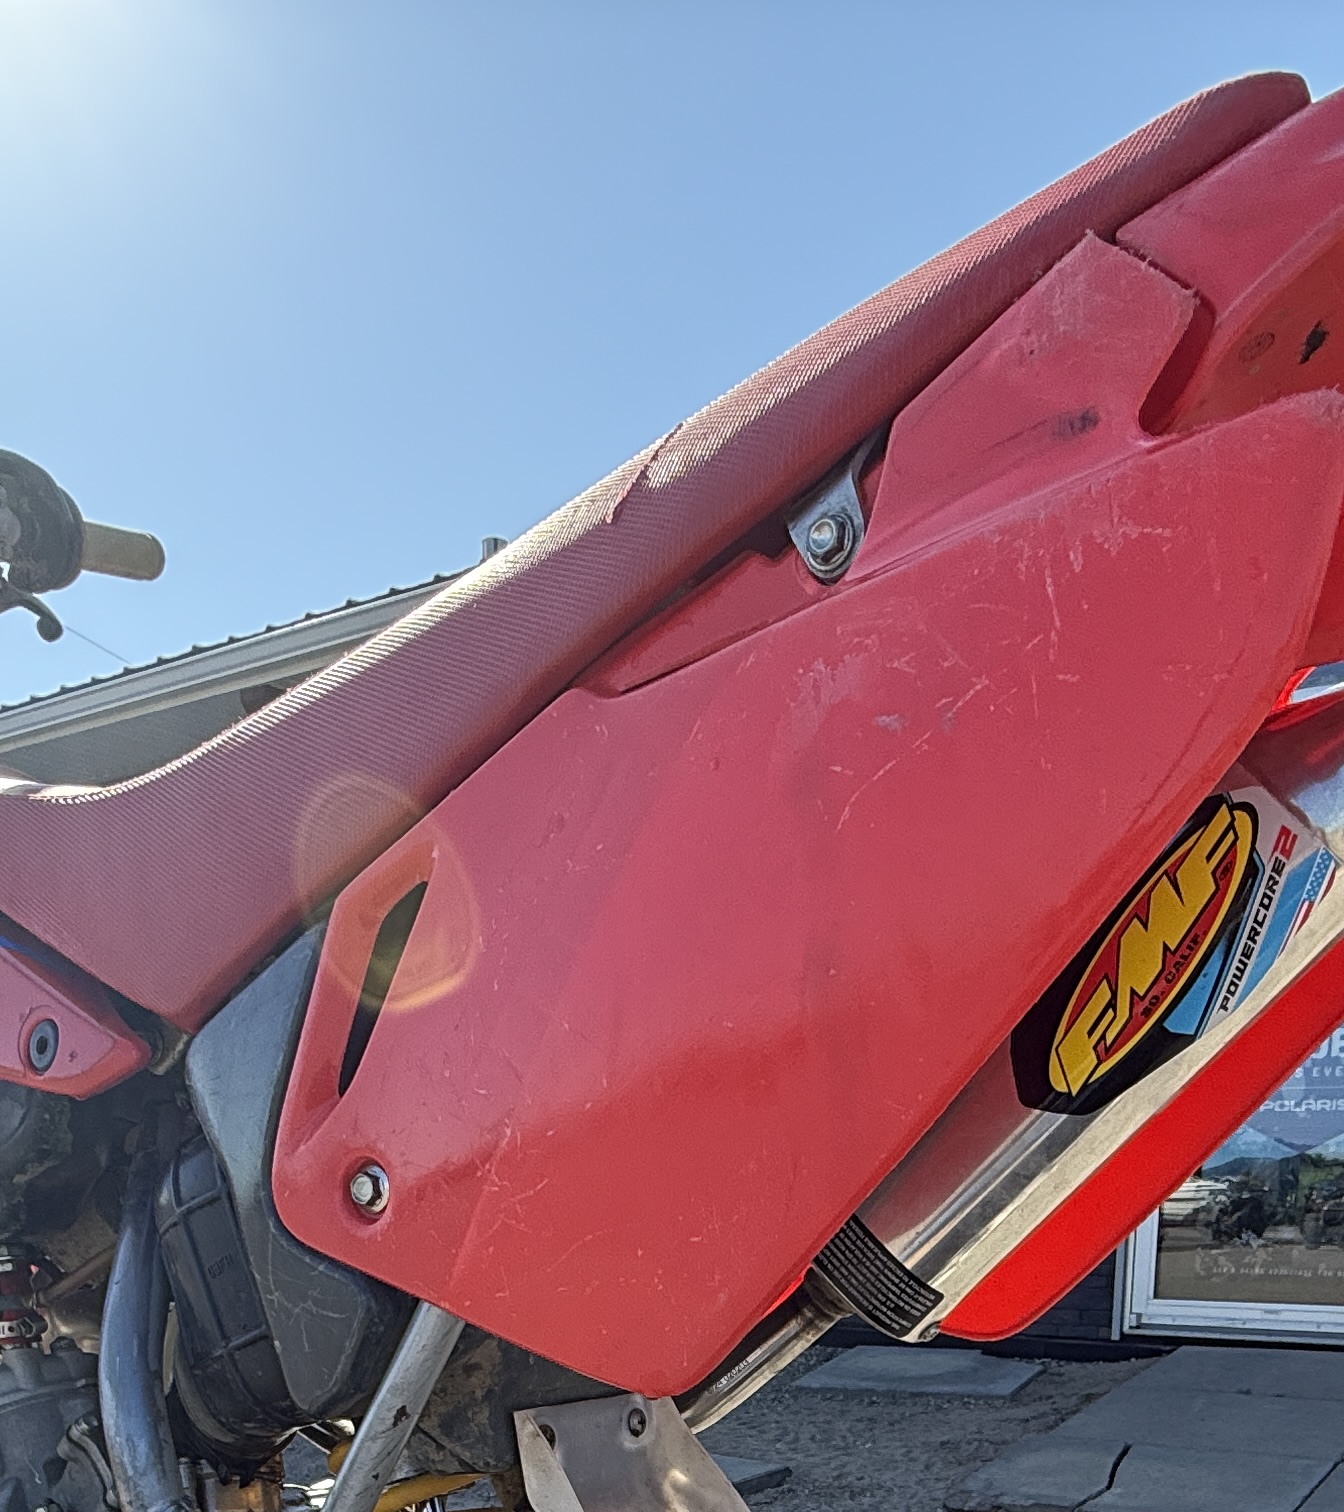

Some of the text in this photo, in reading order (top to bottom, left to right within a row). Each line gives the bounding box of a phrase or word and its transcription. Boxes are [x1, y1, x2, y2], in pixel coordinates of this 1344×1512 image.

[1056, 802, 1239, 1097] FMF
[1217, 825, 1298, 1013] POWERCORE 2
